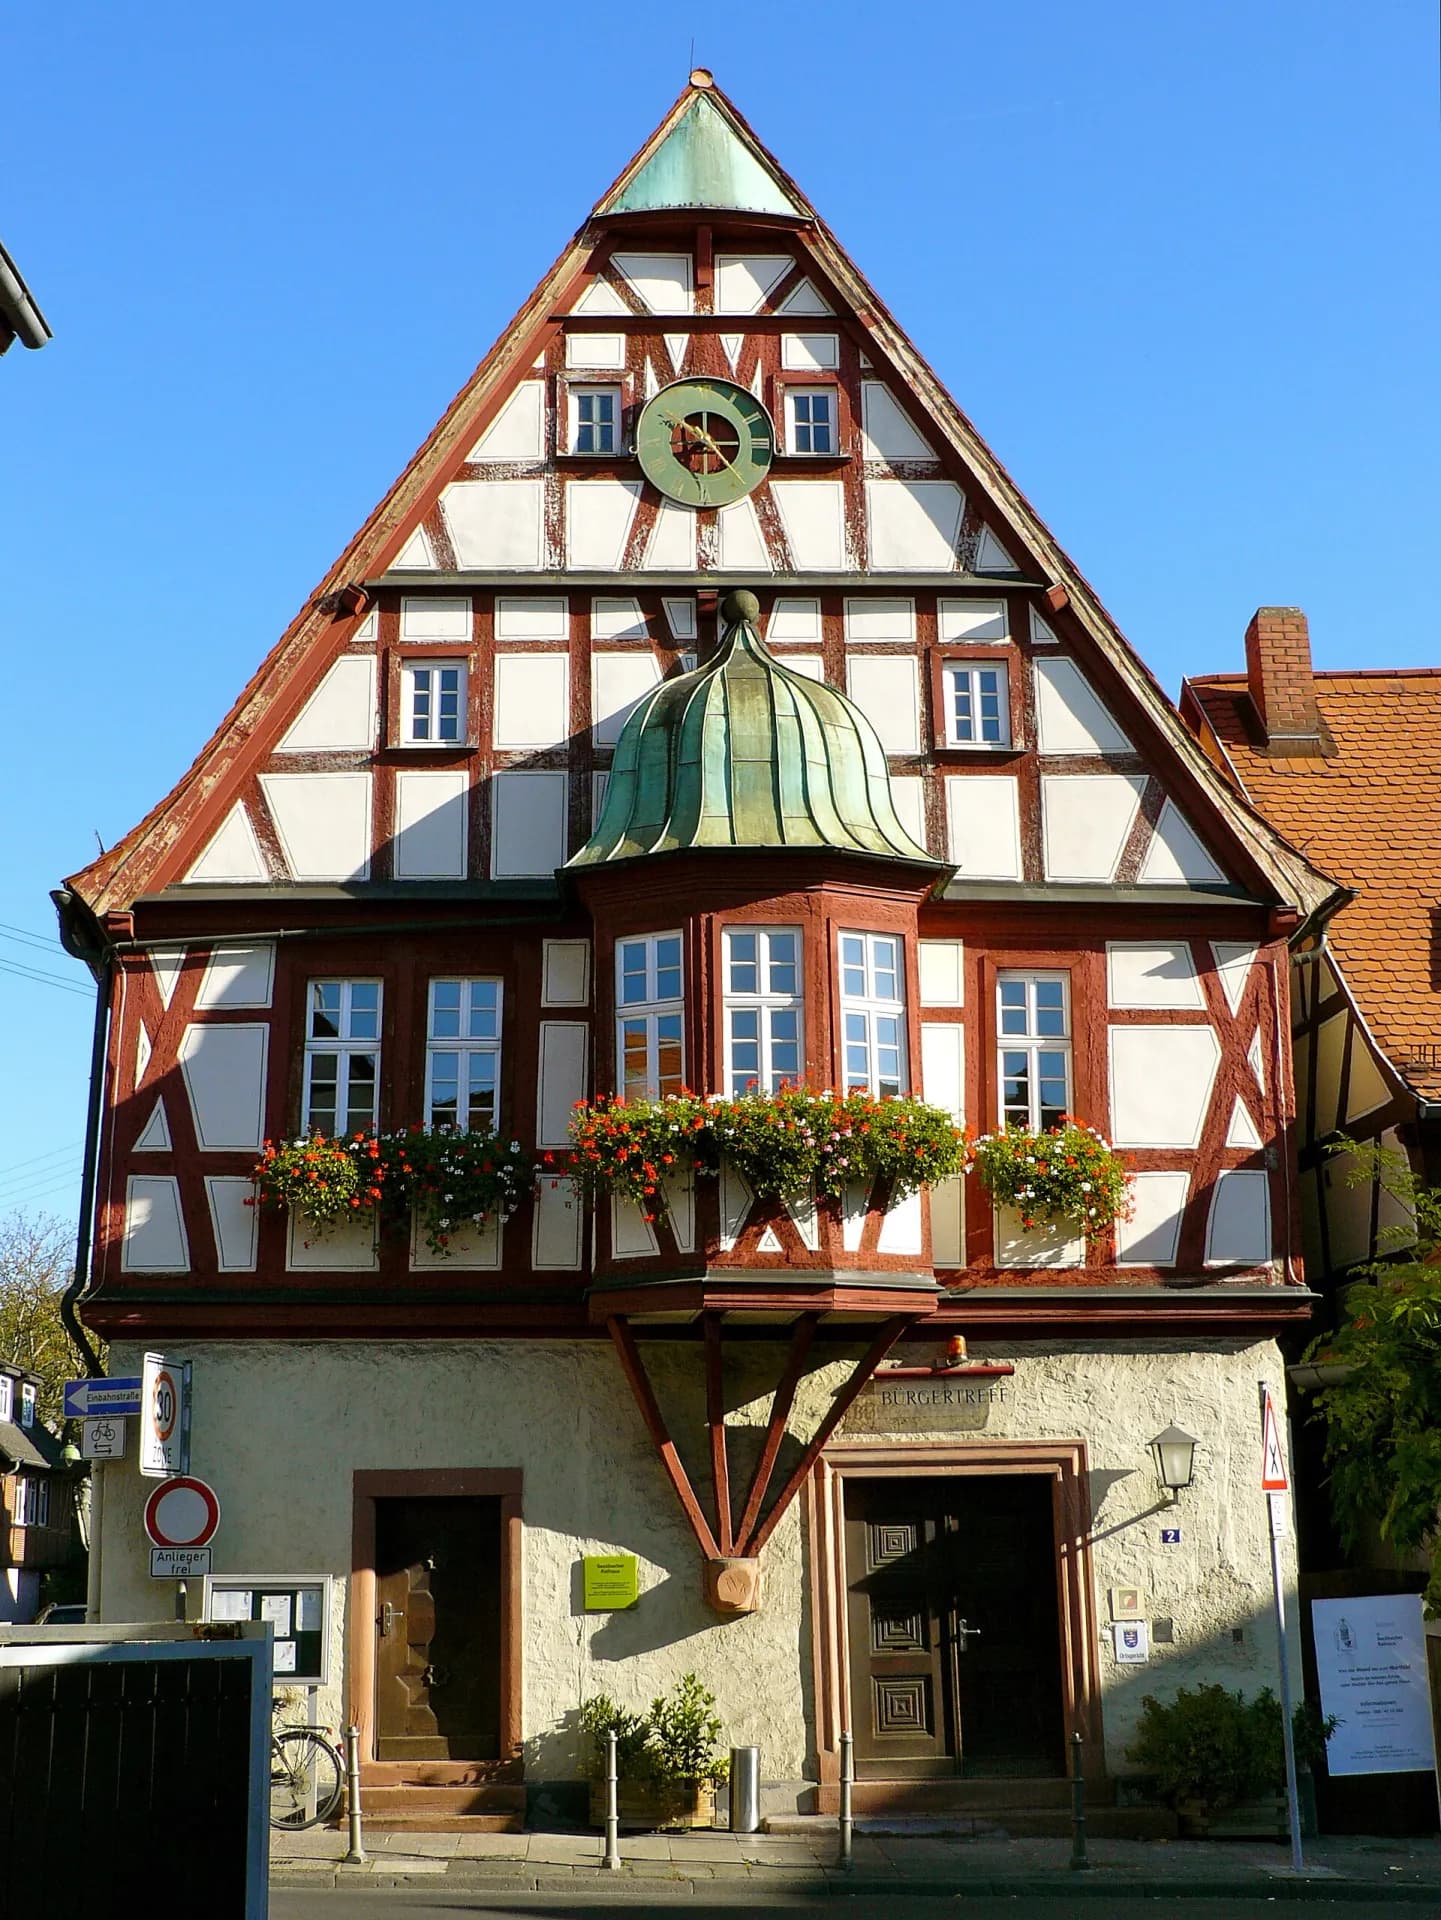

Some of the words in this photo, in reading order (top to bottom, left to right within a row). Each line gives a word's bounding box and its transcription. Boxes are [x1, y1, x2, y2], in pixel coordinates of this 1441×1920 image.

[87, 1391, 139, 1402] Einbahnstraße
[882, 1387, 1008, 1406] BÜRGERTREFF
[157, 1390, 171, 1422] 30
[153, 1446, 172, 1464] ZONE
[1167, 1530, 1175, 1542] 2
[157, 1552, 206, 1564] Anlieger
[171, 1564, 191, 1574] frei
